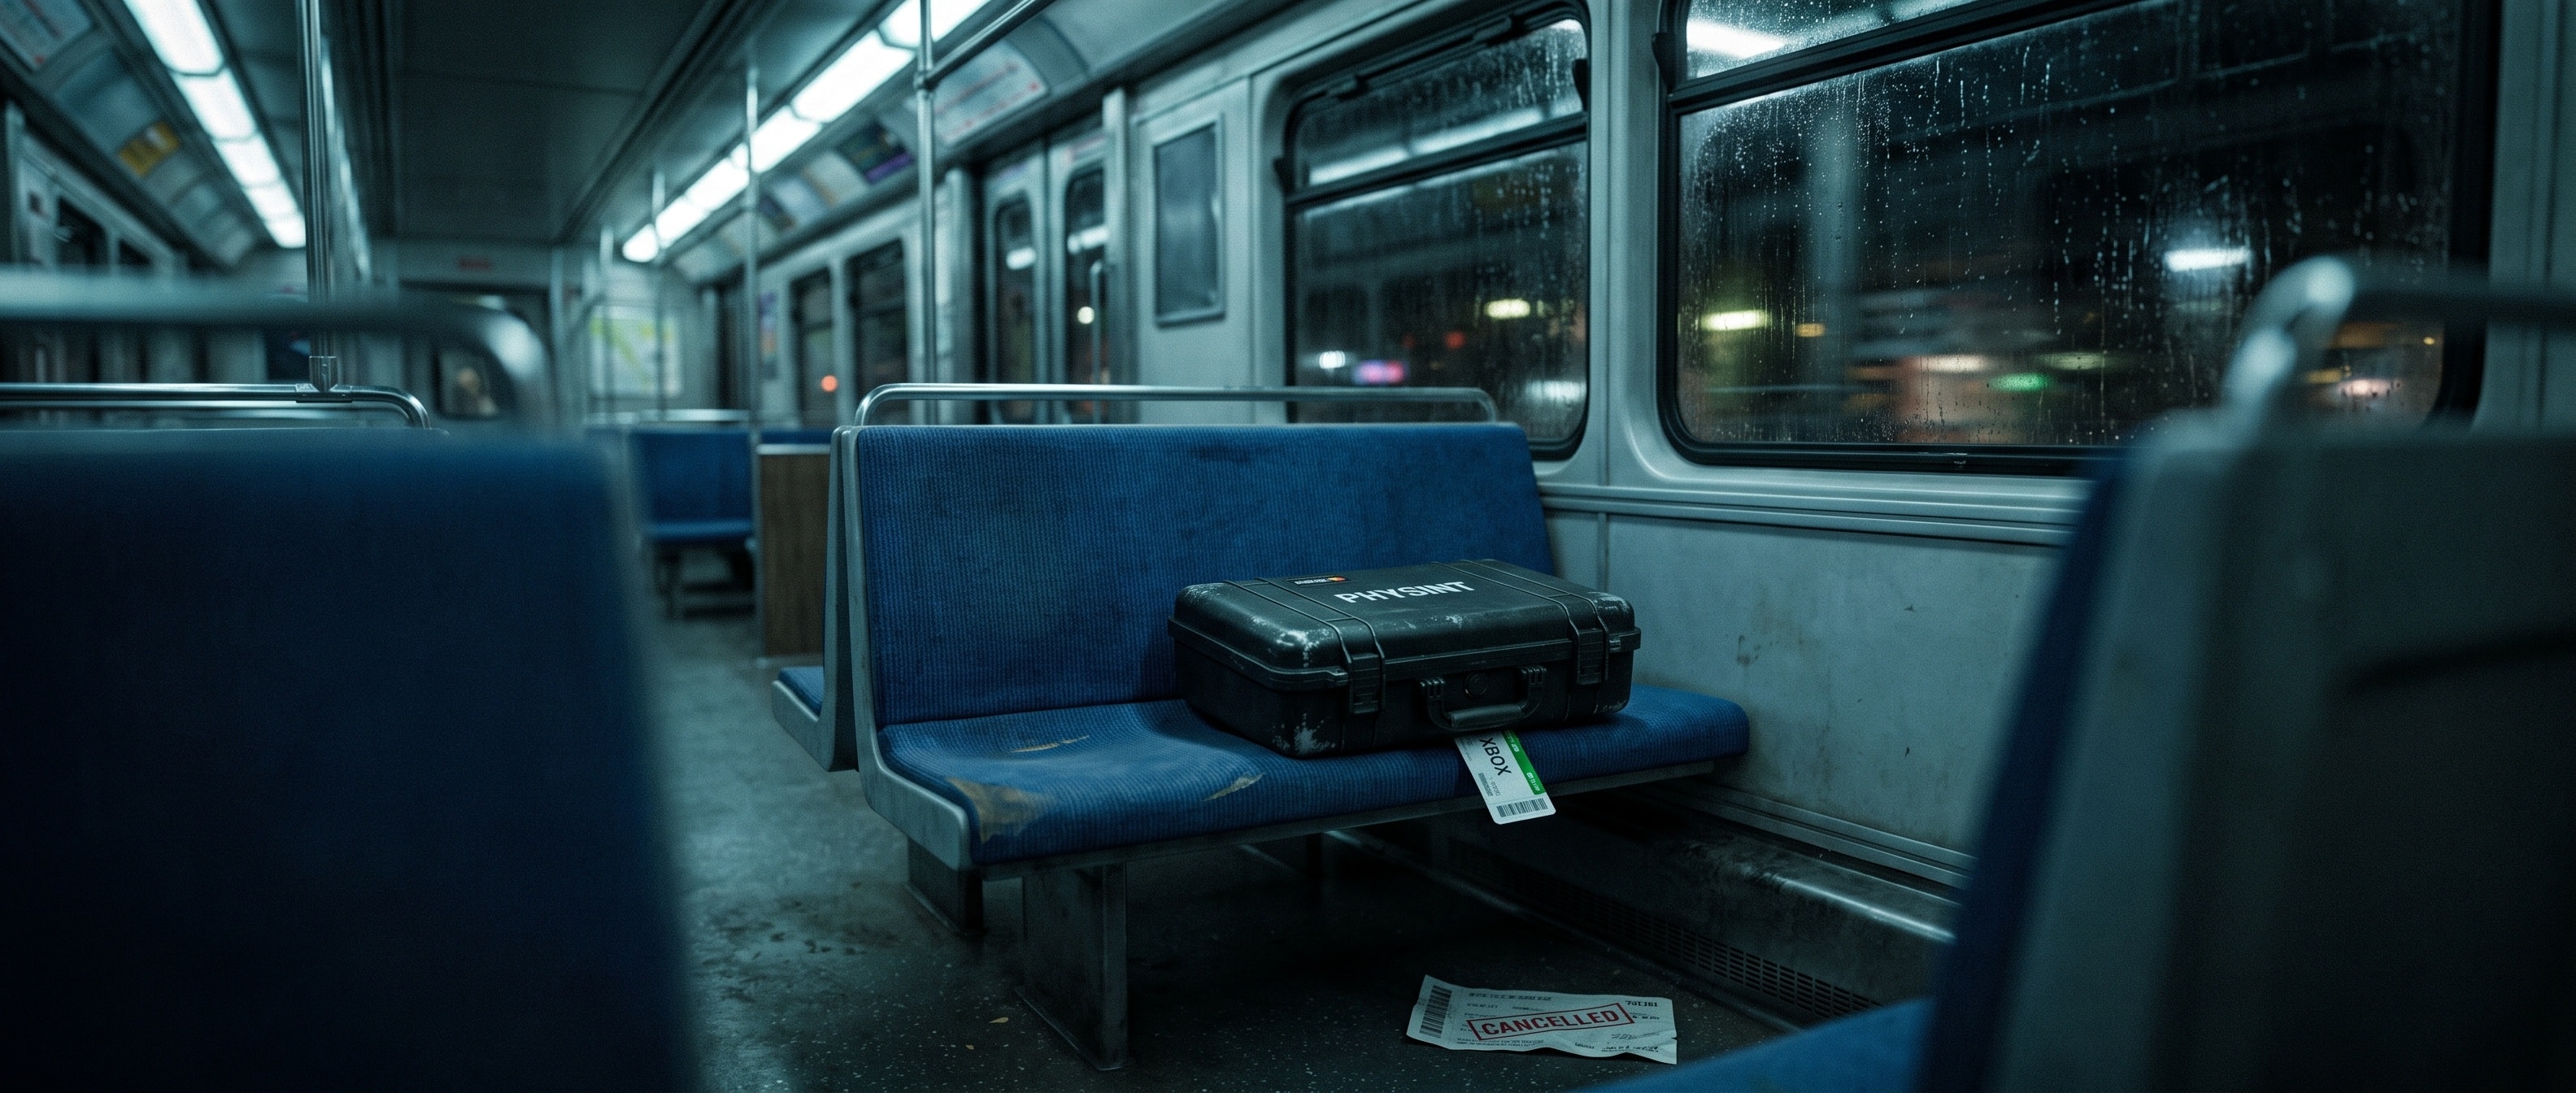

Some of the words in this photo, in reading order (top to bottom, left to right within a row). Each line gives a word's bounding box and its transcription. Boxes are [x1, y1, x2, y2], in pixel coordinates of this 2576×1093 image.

[1334, 581, 1475, 603] PHYSINT
[1479, 738, 1512, 776] XBOX
[1481, 1010, 1619, 1035] CANCELLED
